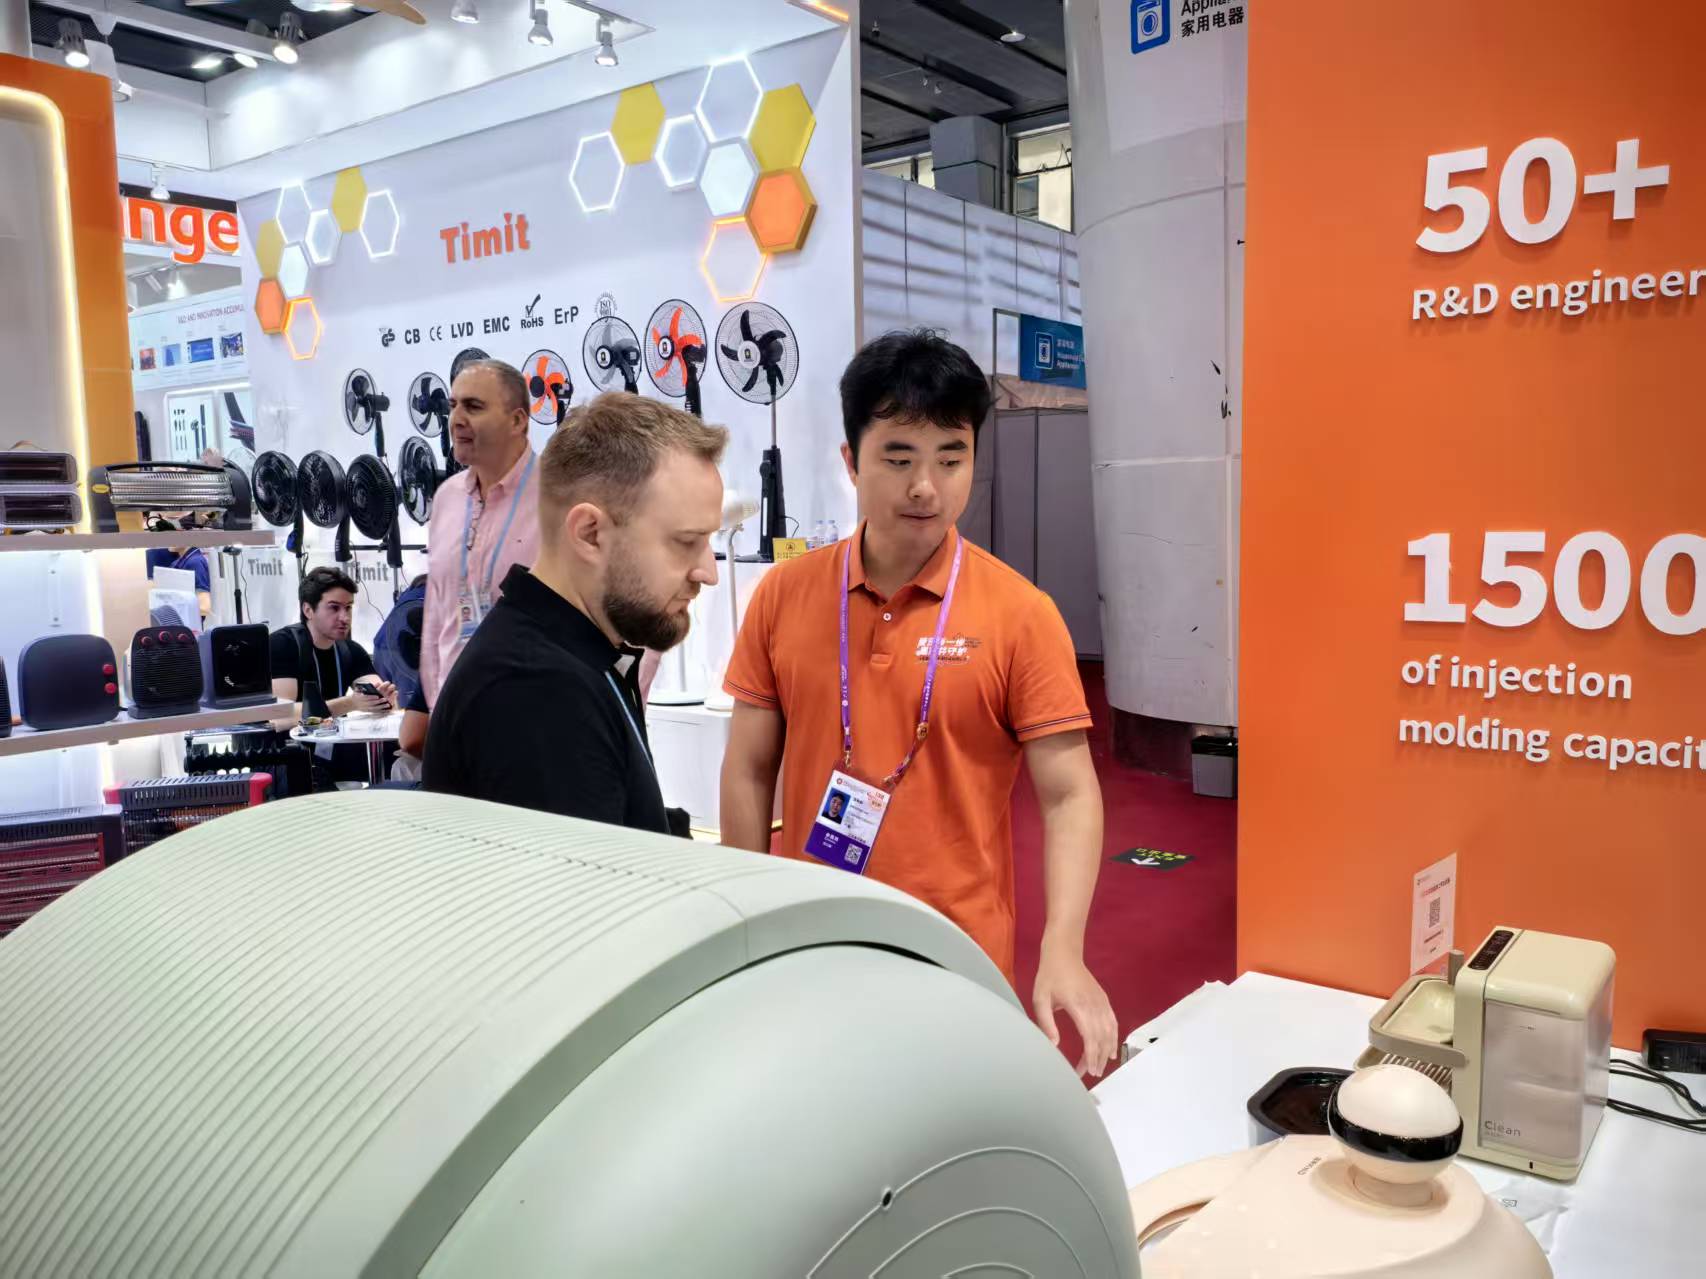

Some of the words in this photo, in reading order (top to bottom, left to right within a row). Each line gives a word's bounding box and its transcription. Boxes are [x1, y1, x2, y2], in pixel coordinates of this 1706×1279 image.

[1181, 6, 1245, 37] 家用电器
[1415, 136, 1670, 253] 50+
[121, 197, 239, 264] nge
[439, 211, 531, 264] Timit
[1411, 282, 1499, 320] R&D
[1510, 268, 1706, 316] engineer
[404, 328, 421, 345] CB
[450, 321, 474, 339] LVD
[483, 316, 511, 334] EMC
[520, 316, 544, 330] RoHS
[554, 306, 580, 325] ErP
[247, 558, 283, 577] Timit
[1401, 654, 1442, 686] of
[1450, 655, 1632, 700] injection
[1399, 715, 1550, 763] molding
[1484, 1119, 1521, 1137] Clean
